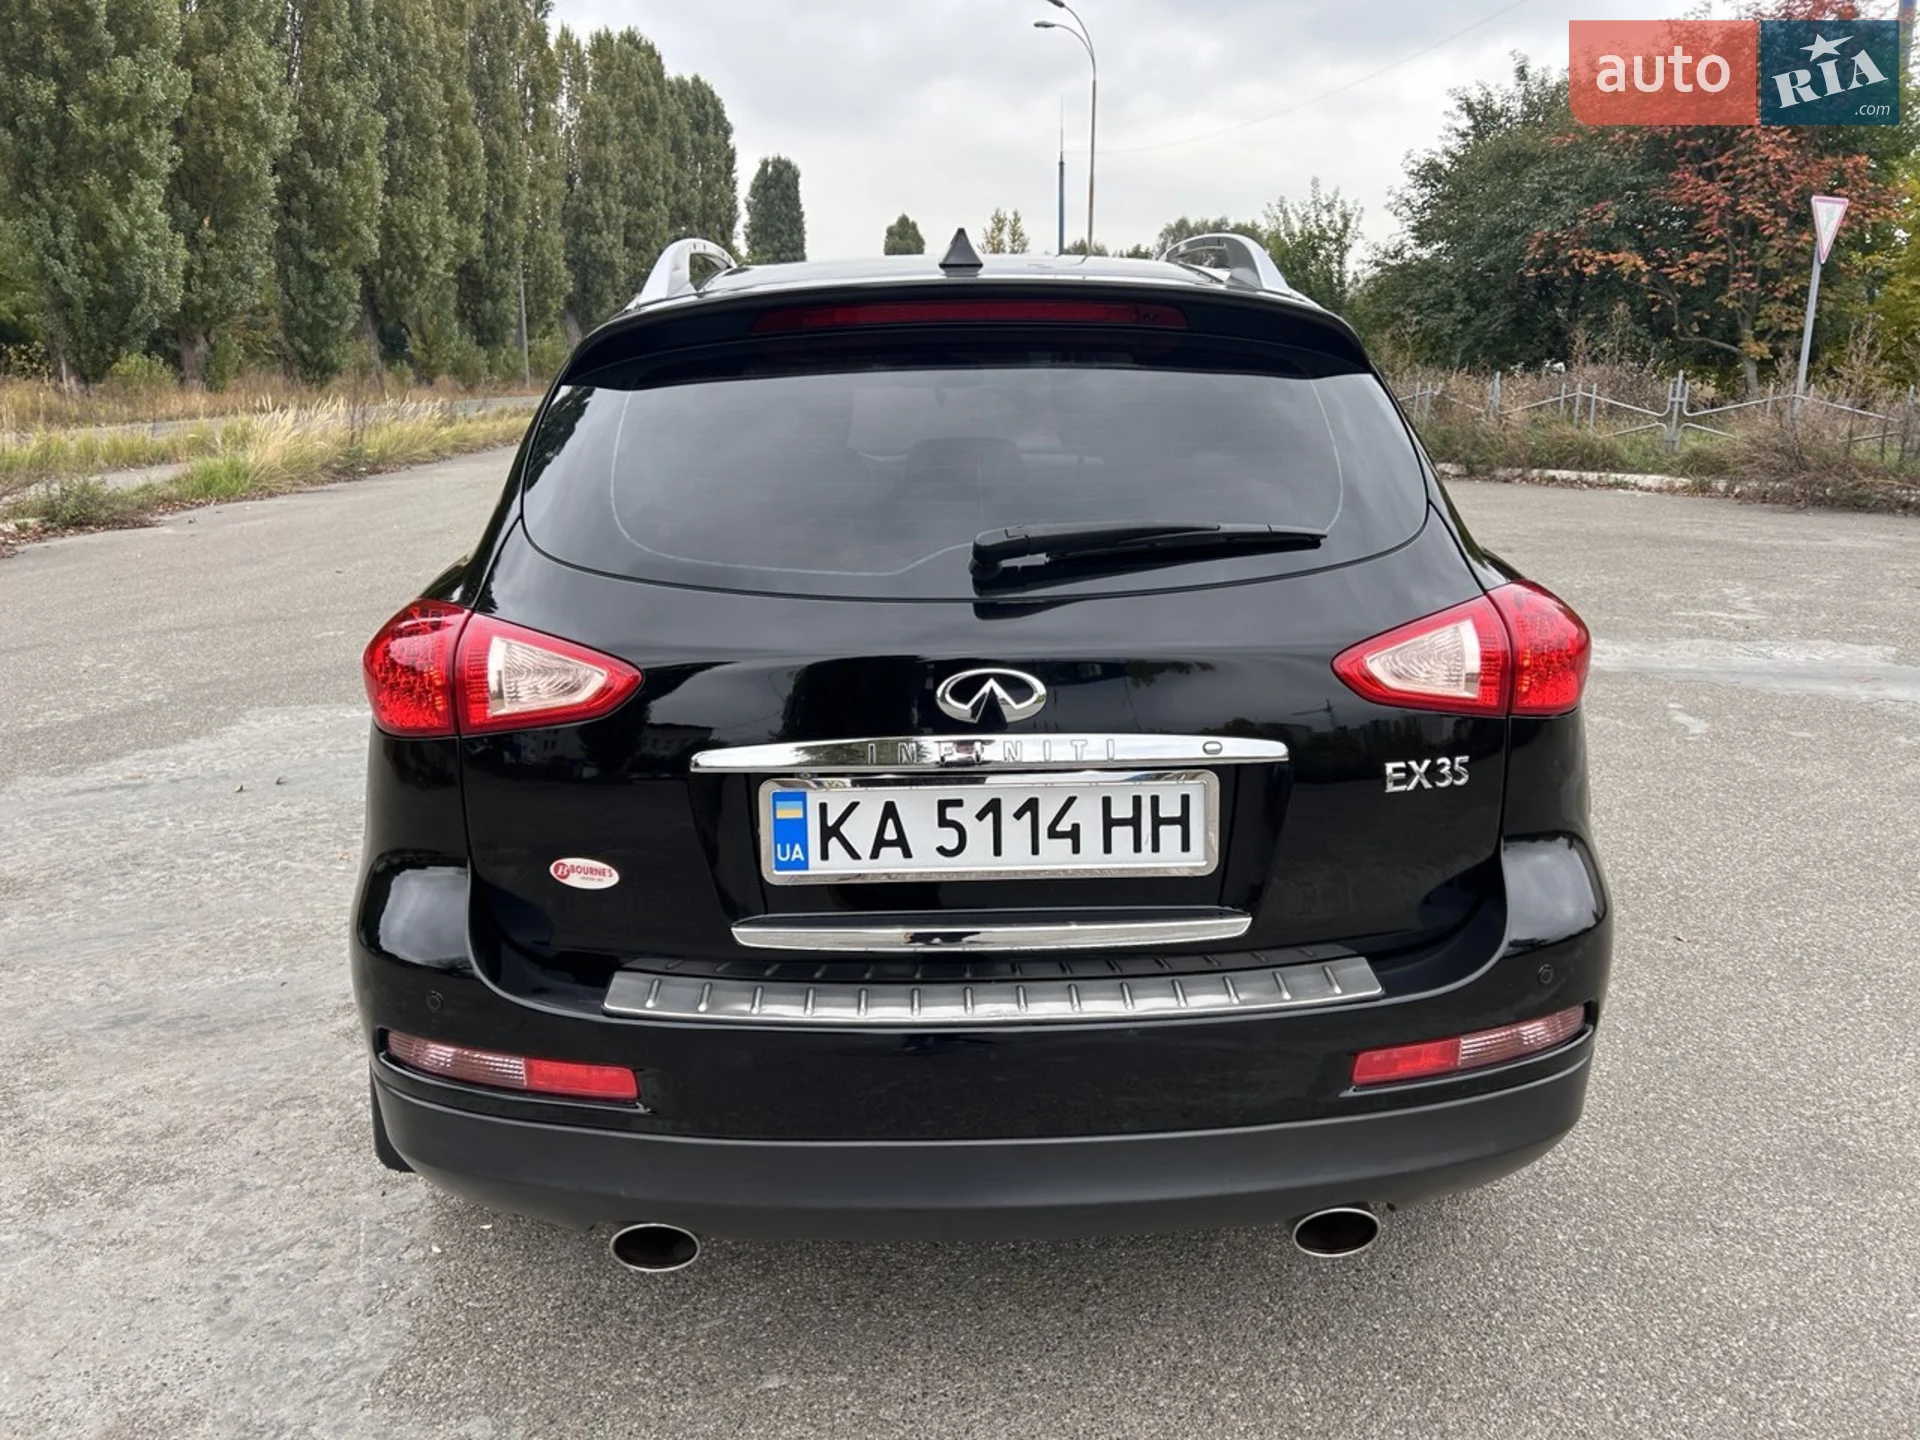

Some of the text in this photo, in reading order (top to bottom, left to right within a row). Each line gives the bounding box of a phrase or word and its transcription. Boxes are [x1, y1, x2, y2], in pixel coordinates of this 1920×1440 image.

[868, 738, 1116, 766] INFINITI
[1384, 755, 1470, 793] EX35
[818, 793, 1191, 862] KA 5114 HH
[776, 843, 805, 863] UA
